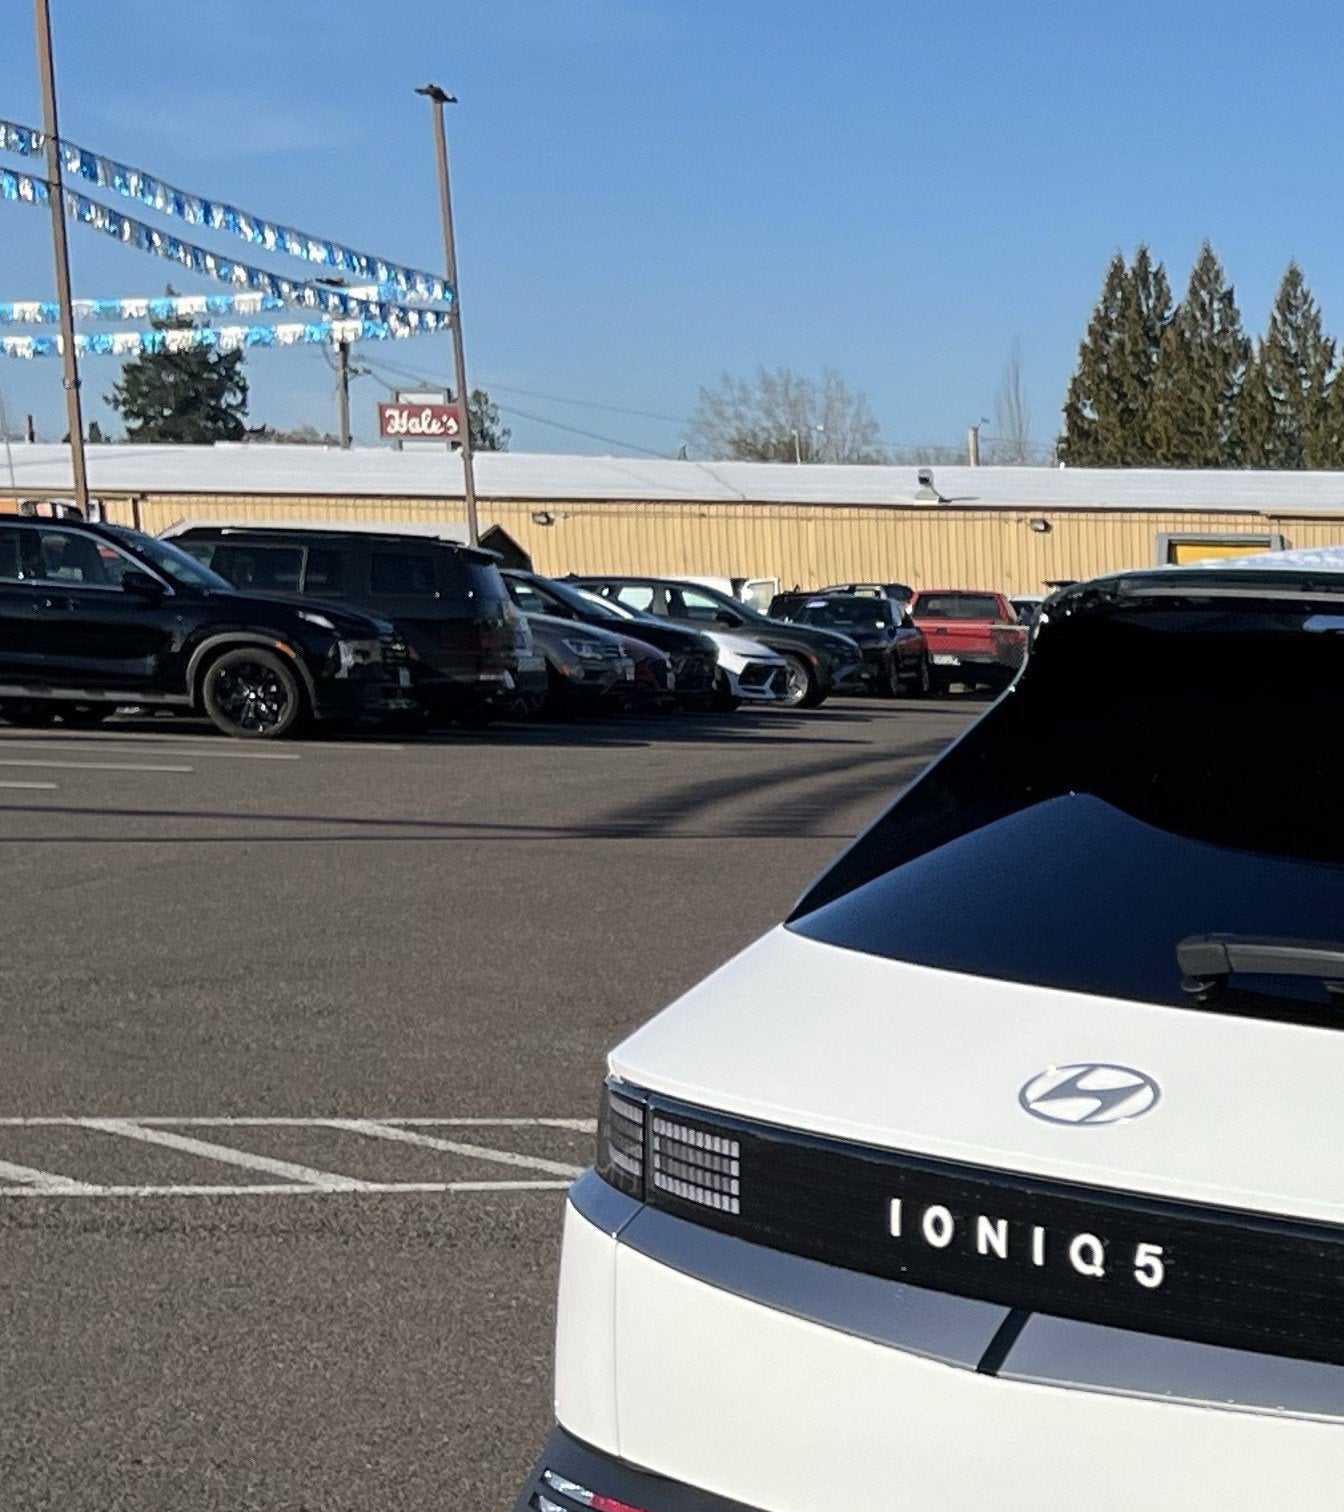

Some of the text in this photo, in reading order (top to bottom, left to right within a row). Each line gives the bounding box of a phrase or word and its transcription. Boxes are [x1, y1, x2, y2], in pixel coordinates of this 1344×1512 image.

[385, 407, 459, 434] Hale's
[890, 1198, 1165, 1288] IONIQ 5
